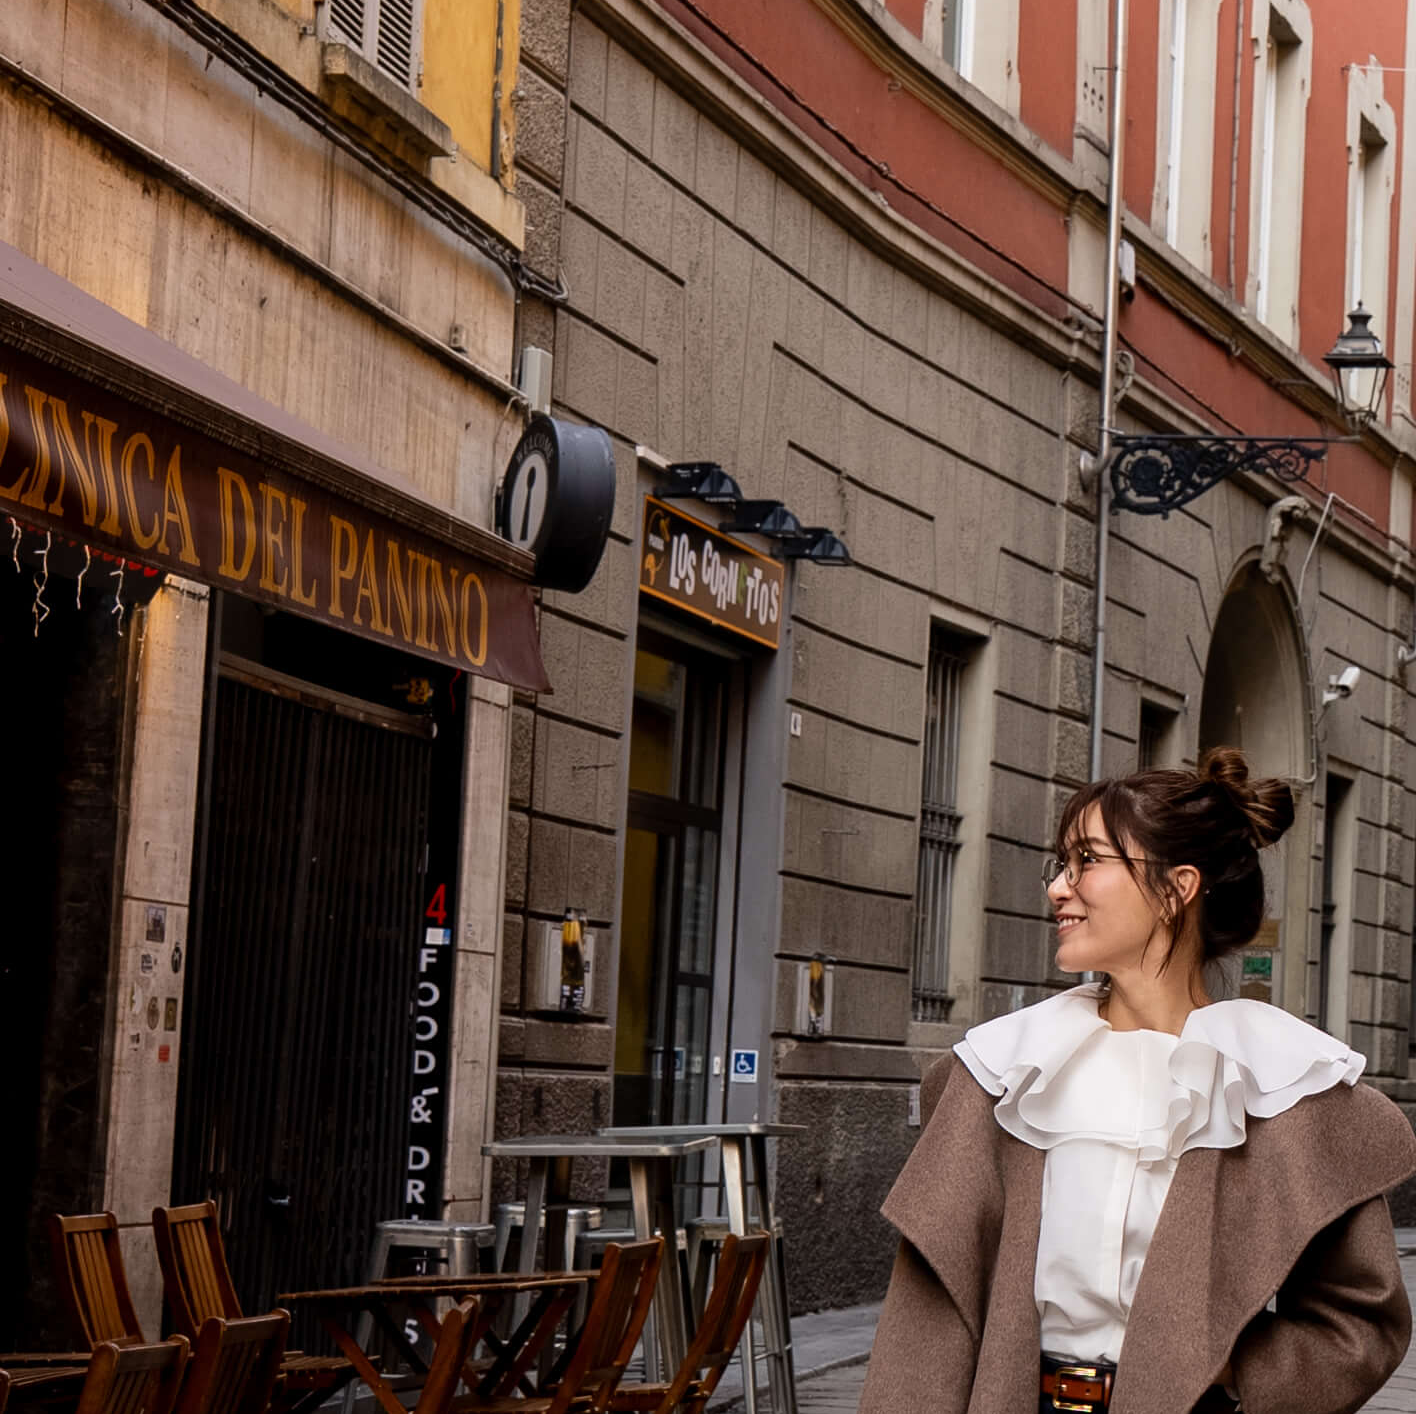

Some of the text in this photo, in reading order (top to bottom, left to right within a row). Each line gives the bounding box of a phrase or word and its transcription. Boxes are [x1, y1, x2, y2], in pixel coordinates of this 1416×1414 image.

[217, 467, 316, 608] DEL
[328, 514, 488, 667] PANINO
[669, 533, 697, 595] LOS
[425, 884, 447, 925] 4
[413, 948, 440, 1075] FOOD
[411, 1095, 432, 1123] &
